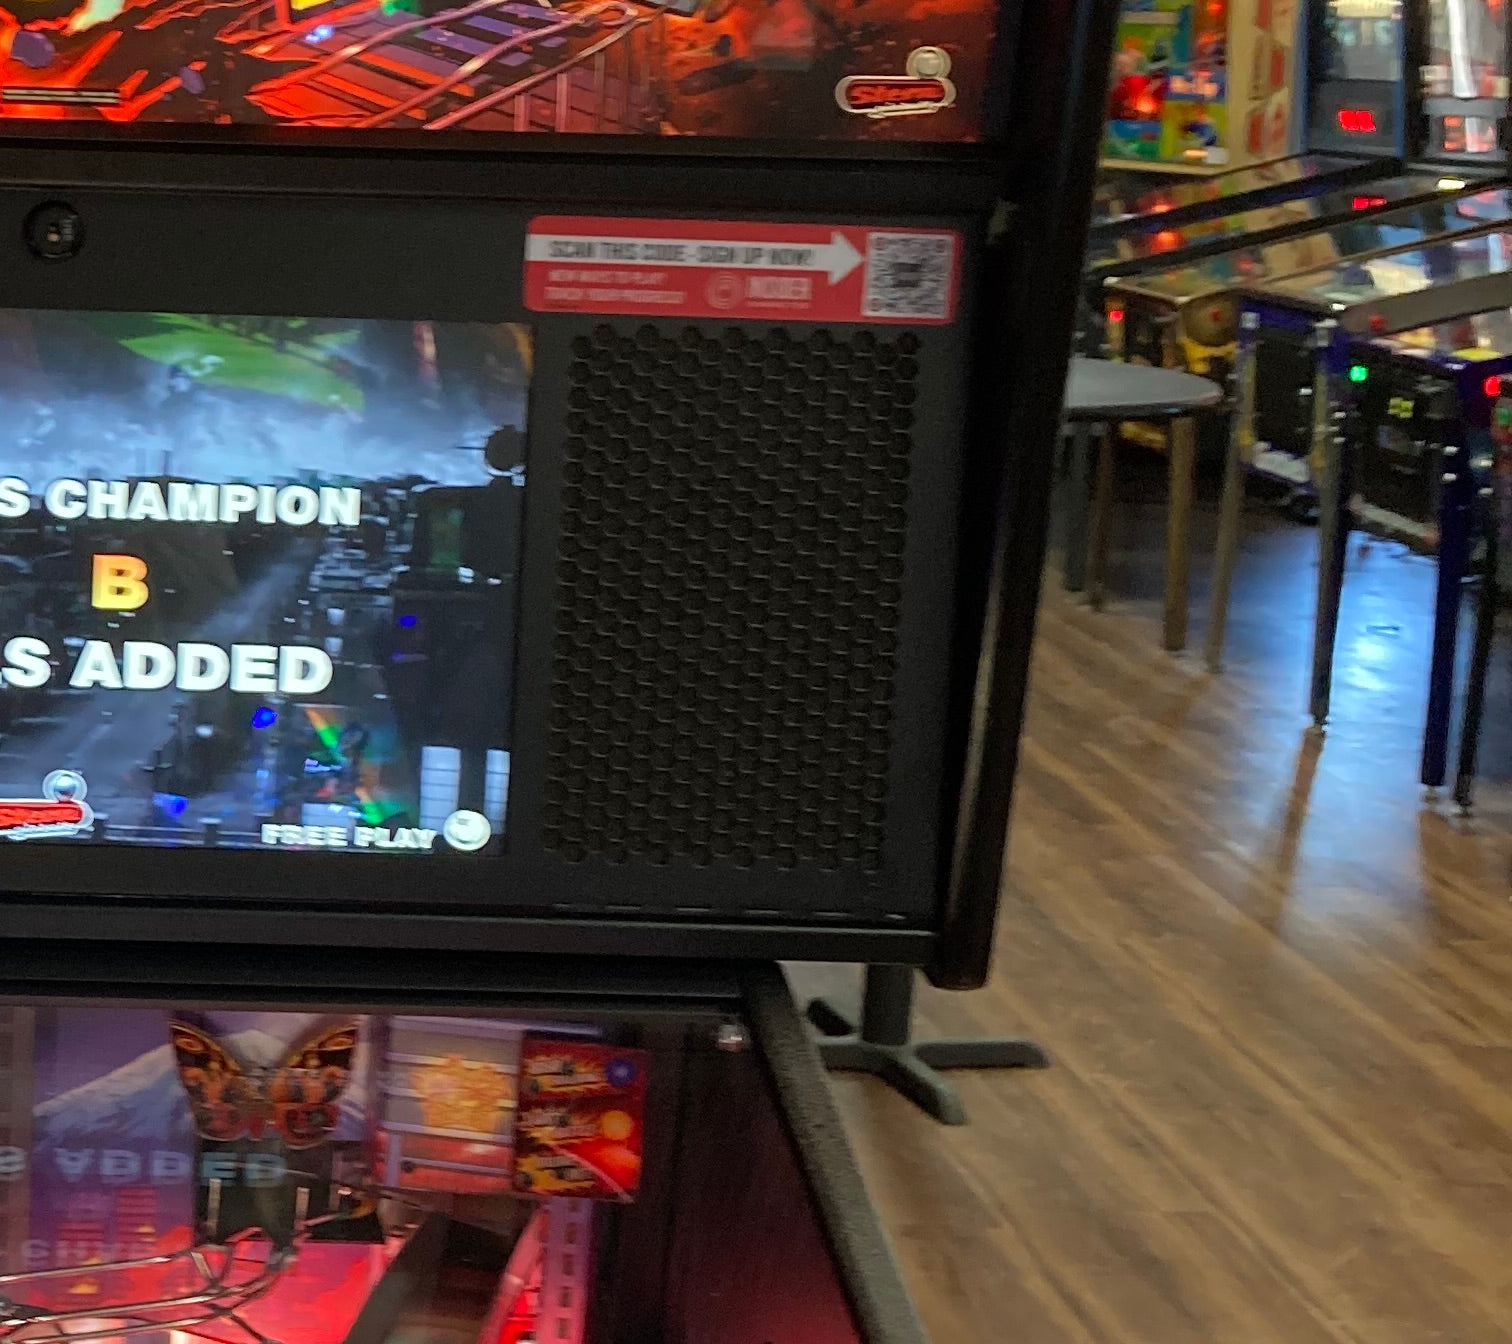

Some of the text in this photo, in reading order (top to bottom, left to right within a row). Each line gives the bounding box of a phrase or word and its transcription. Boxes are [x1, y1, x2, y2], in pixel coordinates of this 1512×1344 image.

[44, 477, 362, 527] CHAMPION
[91, 553, 151, 611] B
[69, 640, 334, 696] ADDED
[260, 823, 438, 850] FREE PLAY
